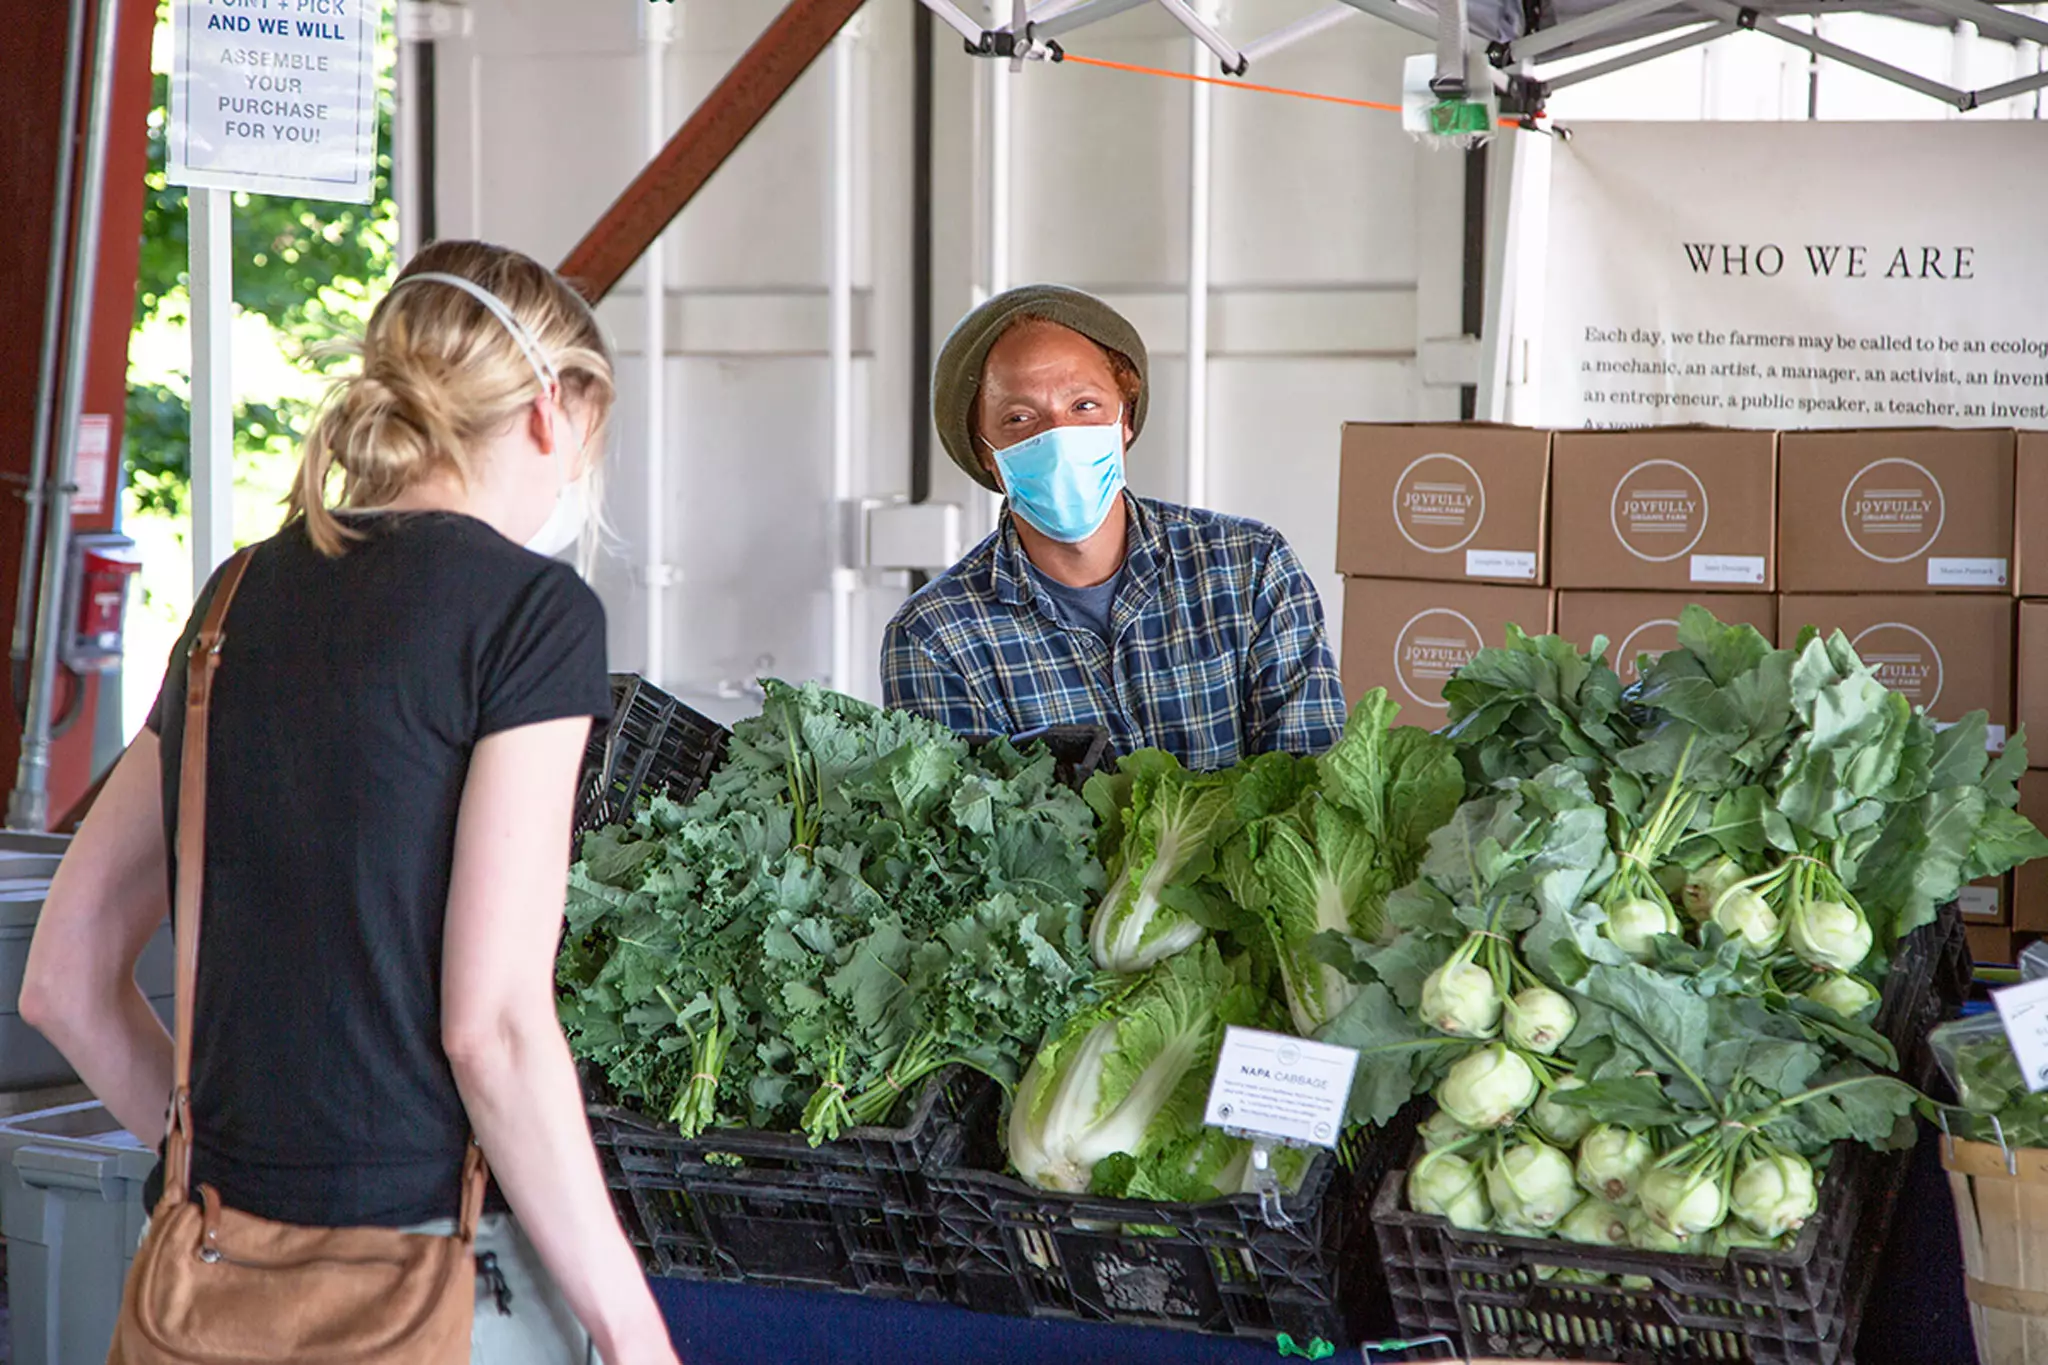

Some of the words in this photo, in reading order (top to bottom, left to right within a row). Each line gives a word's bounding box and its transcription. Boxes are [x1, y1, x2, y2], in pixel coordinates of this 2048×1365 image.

[297, 0, 345, 15] PICK
[208, 14, 250, 32] AND
[258, 18, 289, 35] WE
[296, 21, 345, 40] WILL
[220, 48, 329, 72] ASSEMBLE
[245, 74, 302, 94] YOUR
[218, 96, 328, 120] PURCHASE
[225, 121, 265, 140] FOR
[273, 125, 320, 143] YOU!
[1683, 242, 1784, 277] WHO
[1805, 245, 1867, 278] WE
[1884, 246, 1975, 279] ARE
[1585, 327, 1628, 343] Each
[1631, 328, 1666, 347] day,
[1671, 333, 1694, 344] we
[1698, 330, 1726, 345] the
[1730, 330, 1795, 347] farmers
[1798, 335, 1834, 352] may
[1837, 334, 1856, 349] be
[1860, 335, 1912, 351] called
[1916, 338, 1934, 351] to
[1939, 336, 1959, 352] be
[1964, 341, 1986, 353] an
[1990, 338, 2048, 358] ecolog
[1581, 361, 1591, 372] a
[1596, 359, 1682, 376] mechanic,
[1685, 364, 1706, 376] an
[1710, 361, 1762, 379] artist,
[1766, 366, 1777, 377] a
[1782, 366, 1860, 384] manager,
[1865, 369, 1886, 382] an
[1890, 367, 1961, 386] activist,
[1966, 372, 1988, 386] an
[1584, 391, 1605, 403] an
[1610, 389, 1723, 408] entrepreneur,
[1728, 396, 1738, 407] a
[1742, 393, 1794, 412] public
[1798, 396, 1870, 414] speaker,
[1874, 401, 1884, 413] a
[1889, 398, 1959, 417] teacher,
[1964, 404, 1986, 418] an
[1991, 401, 2048, 419] invest
[1403, 492, 1474, 507] JOYFULLY
[1622, 500, 1696, 515] JOYFULLY
[1853, 501, 1932, 515] JOYFULLY
[1405, 646, 1474, 661] JOYFULLY
[1240, 1066, 1271, 1078] NAPA
[1274, 1071, 1329, 1089] CABBAGE
